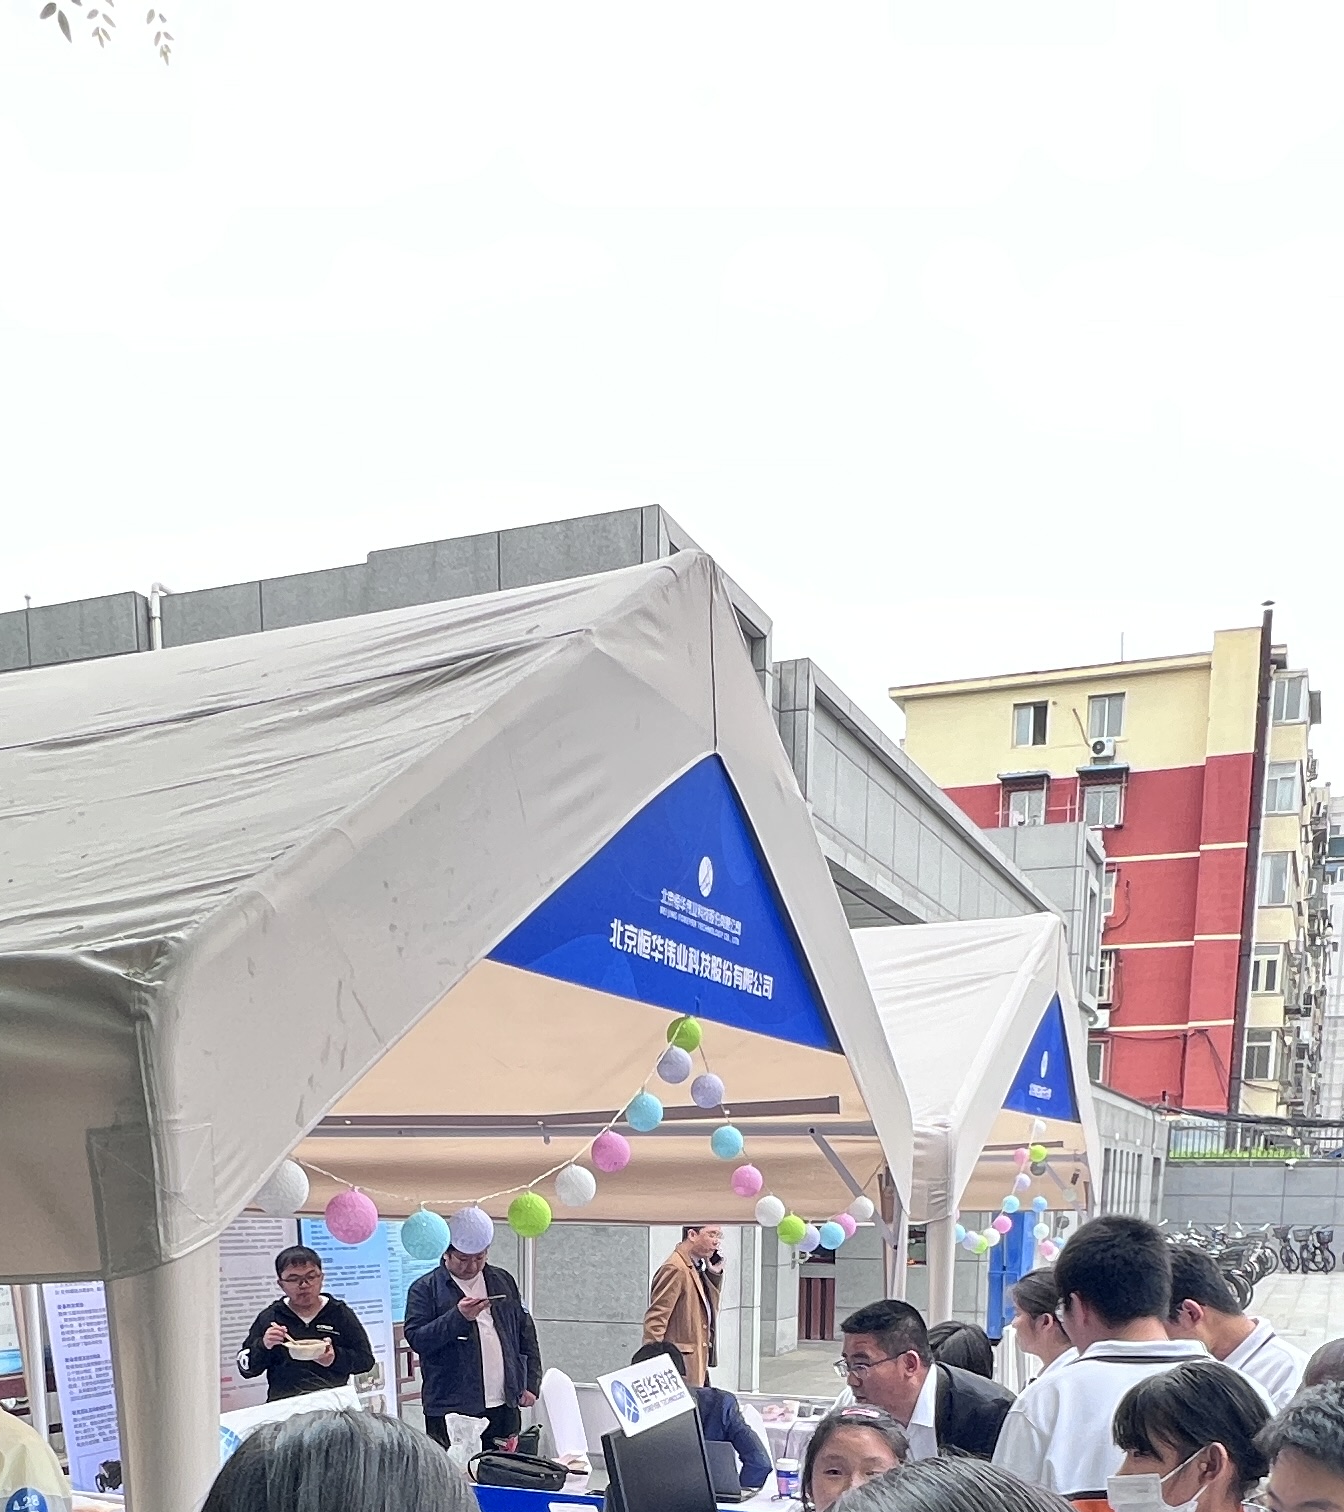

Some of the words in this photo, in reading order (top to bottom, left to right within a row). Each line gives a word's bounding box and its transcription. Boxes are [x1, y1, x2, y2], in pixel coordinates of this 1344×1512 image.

[609, 917, 774, 1000] 北京恒华伟业科技股份有限公司
[631, 1369, 683, 1404] 恒华科技
